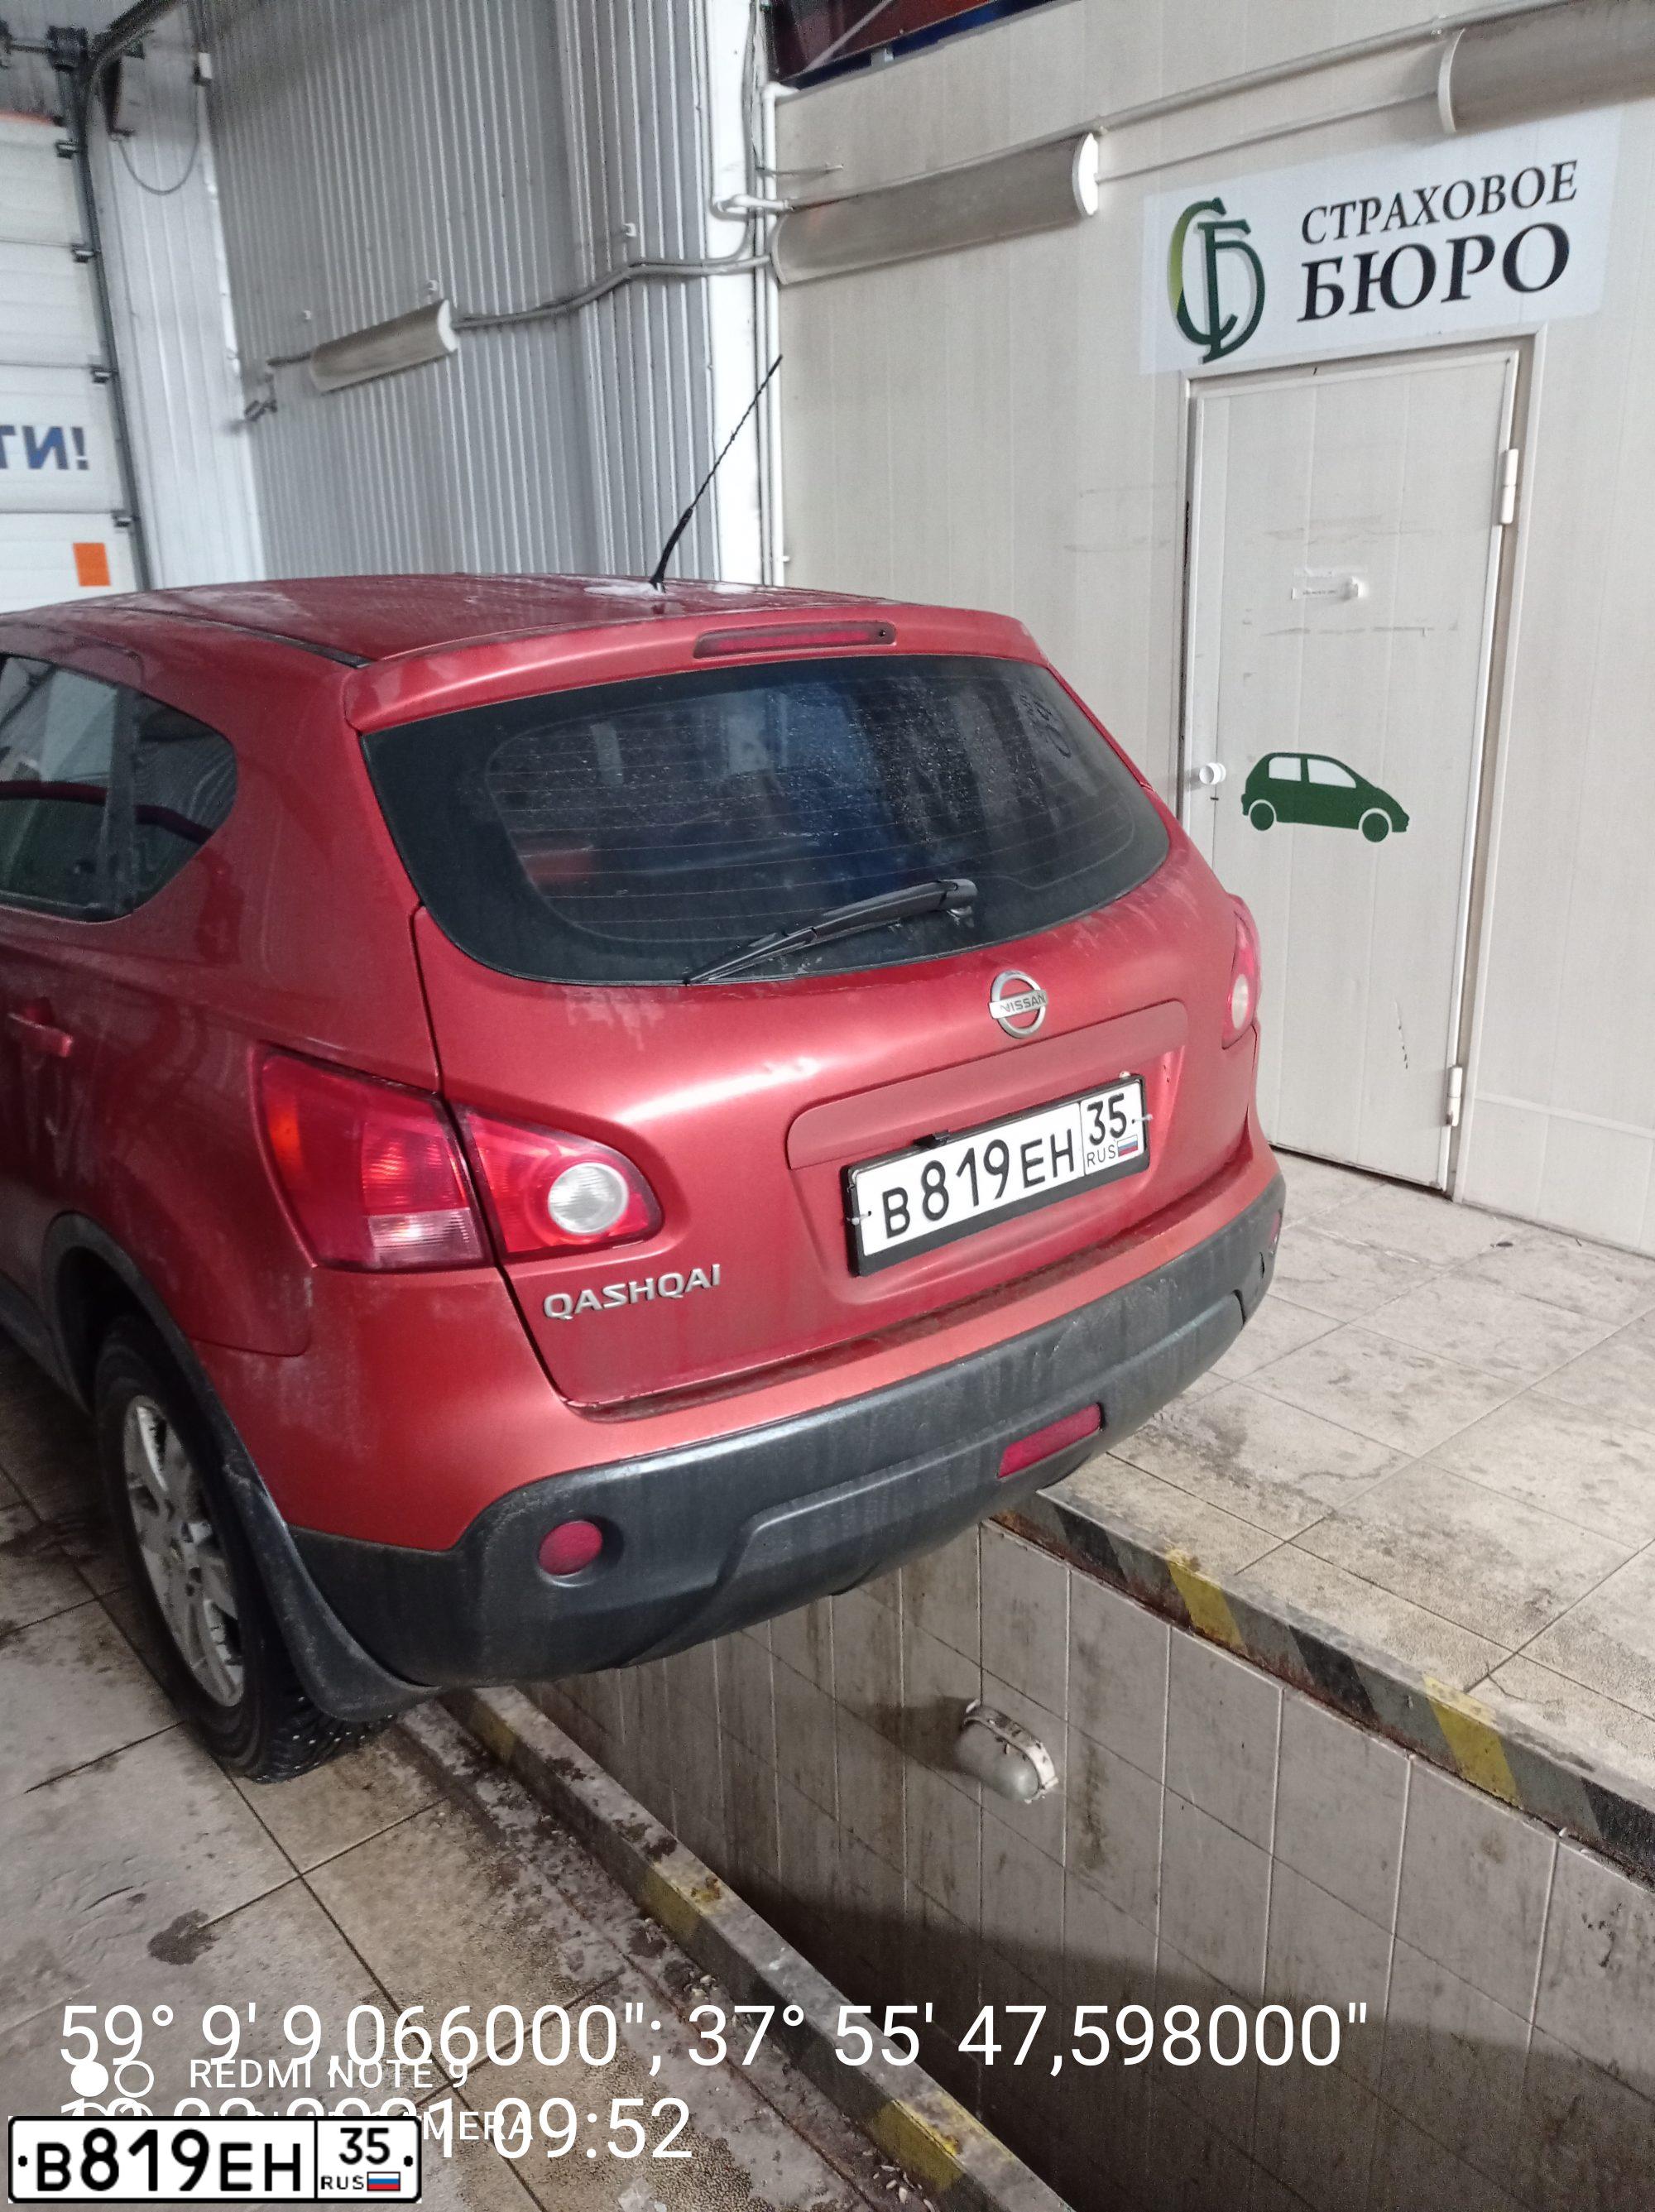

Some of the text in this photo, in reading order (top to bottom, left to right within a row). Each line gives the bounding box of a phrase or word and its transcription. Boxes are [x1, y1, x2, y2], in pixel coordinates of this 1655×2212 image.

[1302, 160, 1578, 244] СТРАХОВОЕ
[1297, 222, 1571, 322] БЮРО
[1000, 995, 1046, 1012] NISSAN
[1087, 1093, 1127, 1146] 35
[1086, 1145, 1116, 1168] RUS
[543, 1264, 721, 1320] QASHQAI
